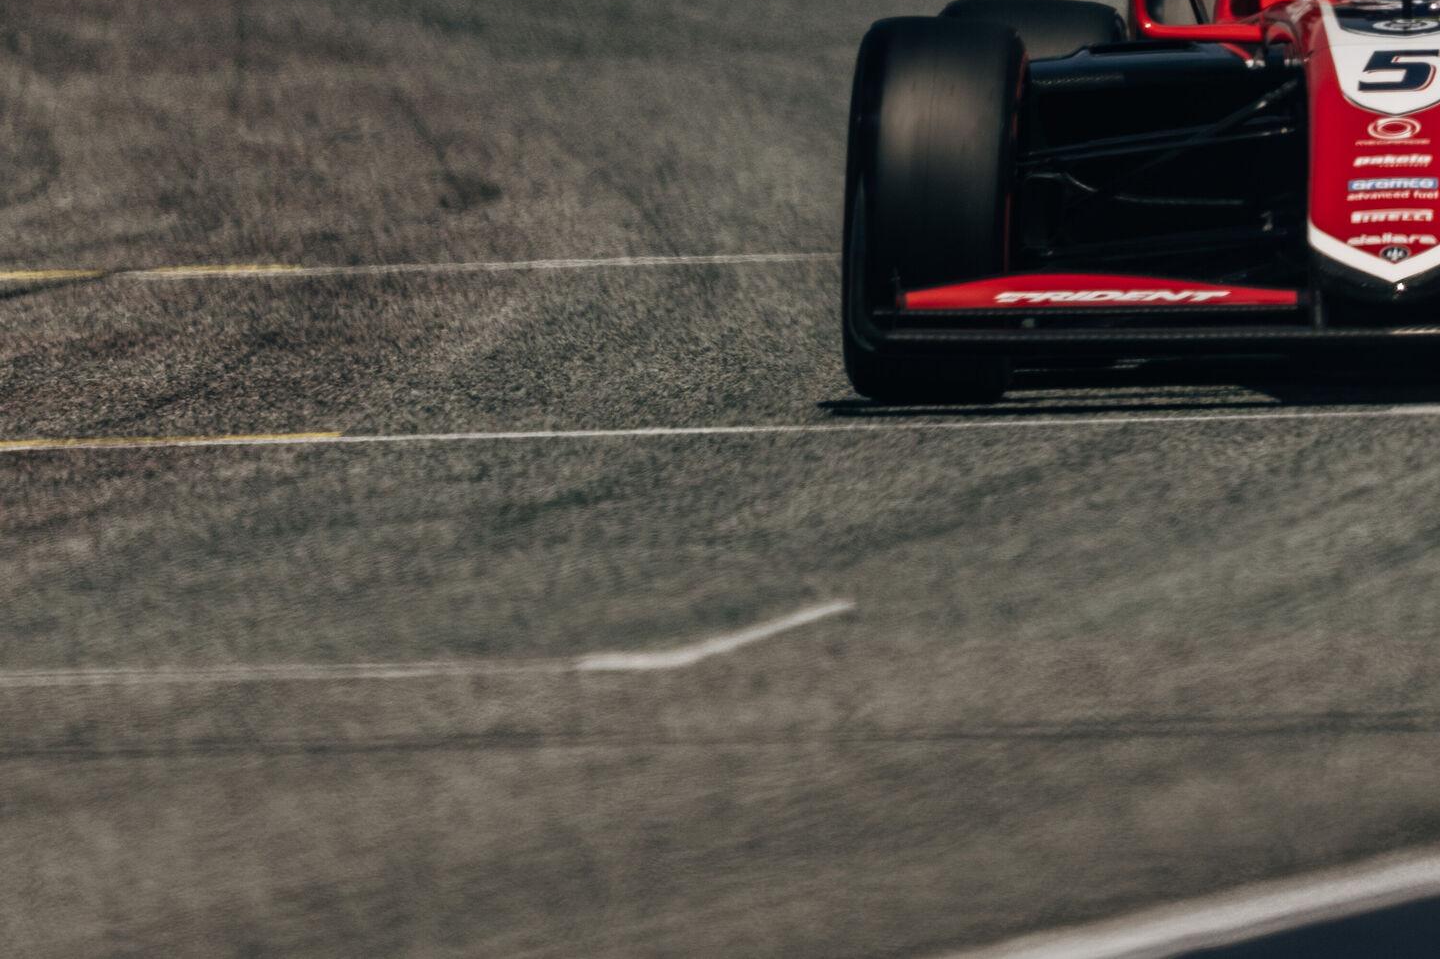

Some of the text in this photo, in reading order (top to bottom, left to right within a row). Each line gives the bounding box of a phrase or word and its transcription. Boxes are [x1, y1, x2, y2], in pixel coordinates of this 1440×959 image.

[1351, 179, 1434, 191] aramco
[1347, 190, 1439, 201] advanced fuel
[1347, 232, 1438, 245] dallara
[994, 290, 1231, 303] TRIDENT
